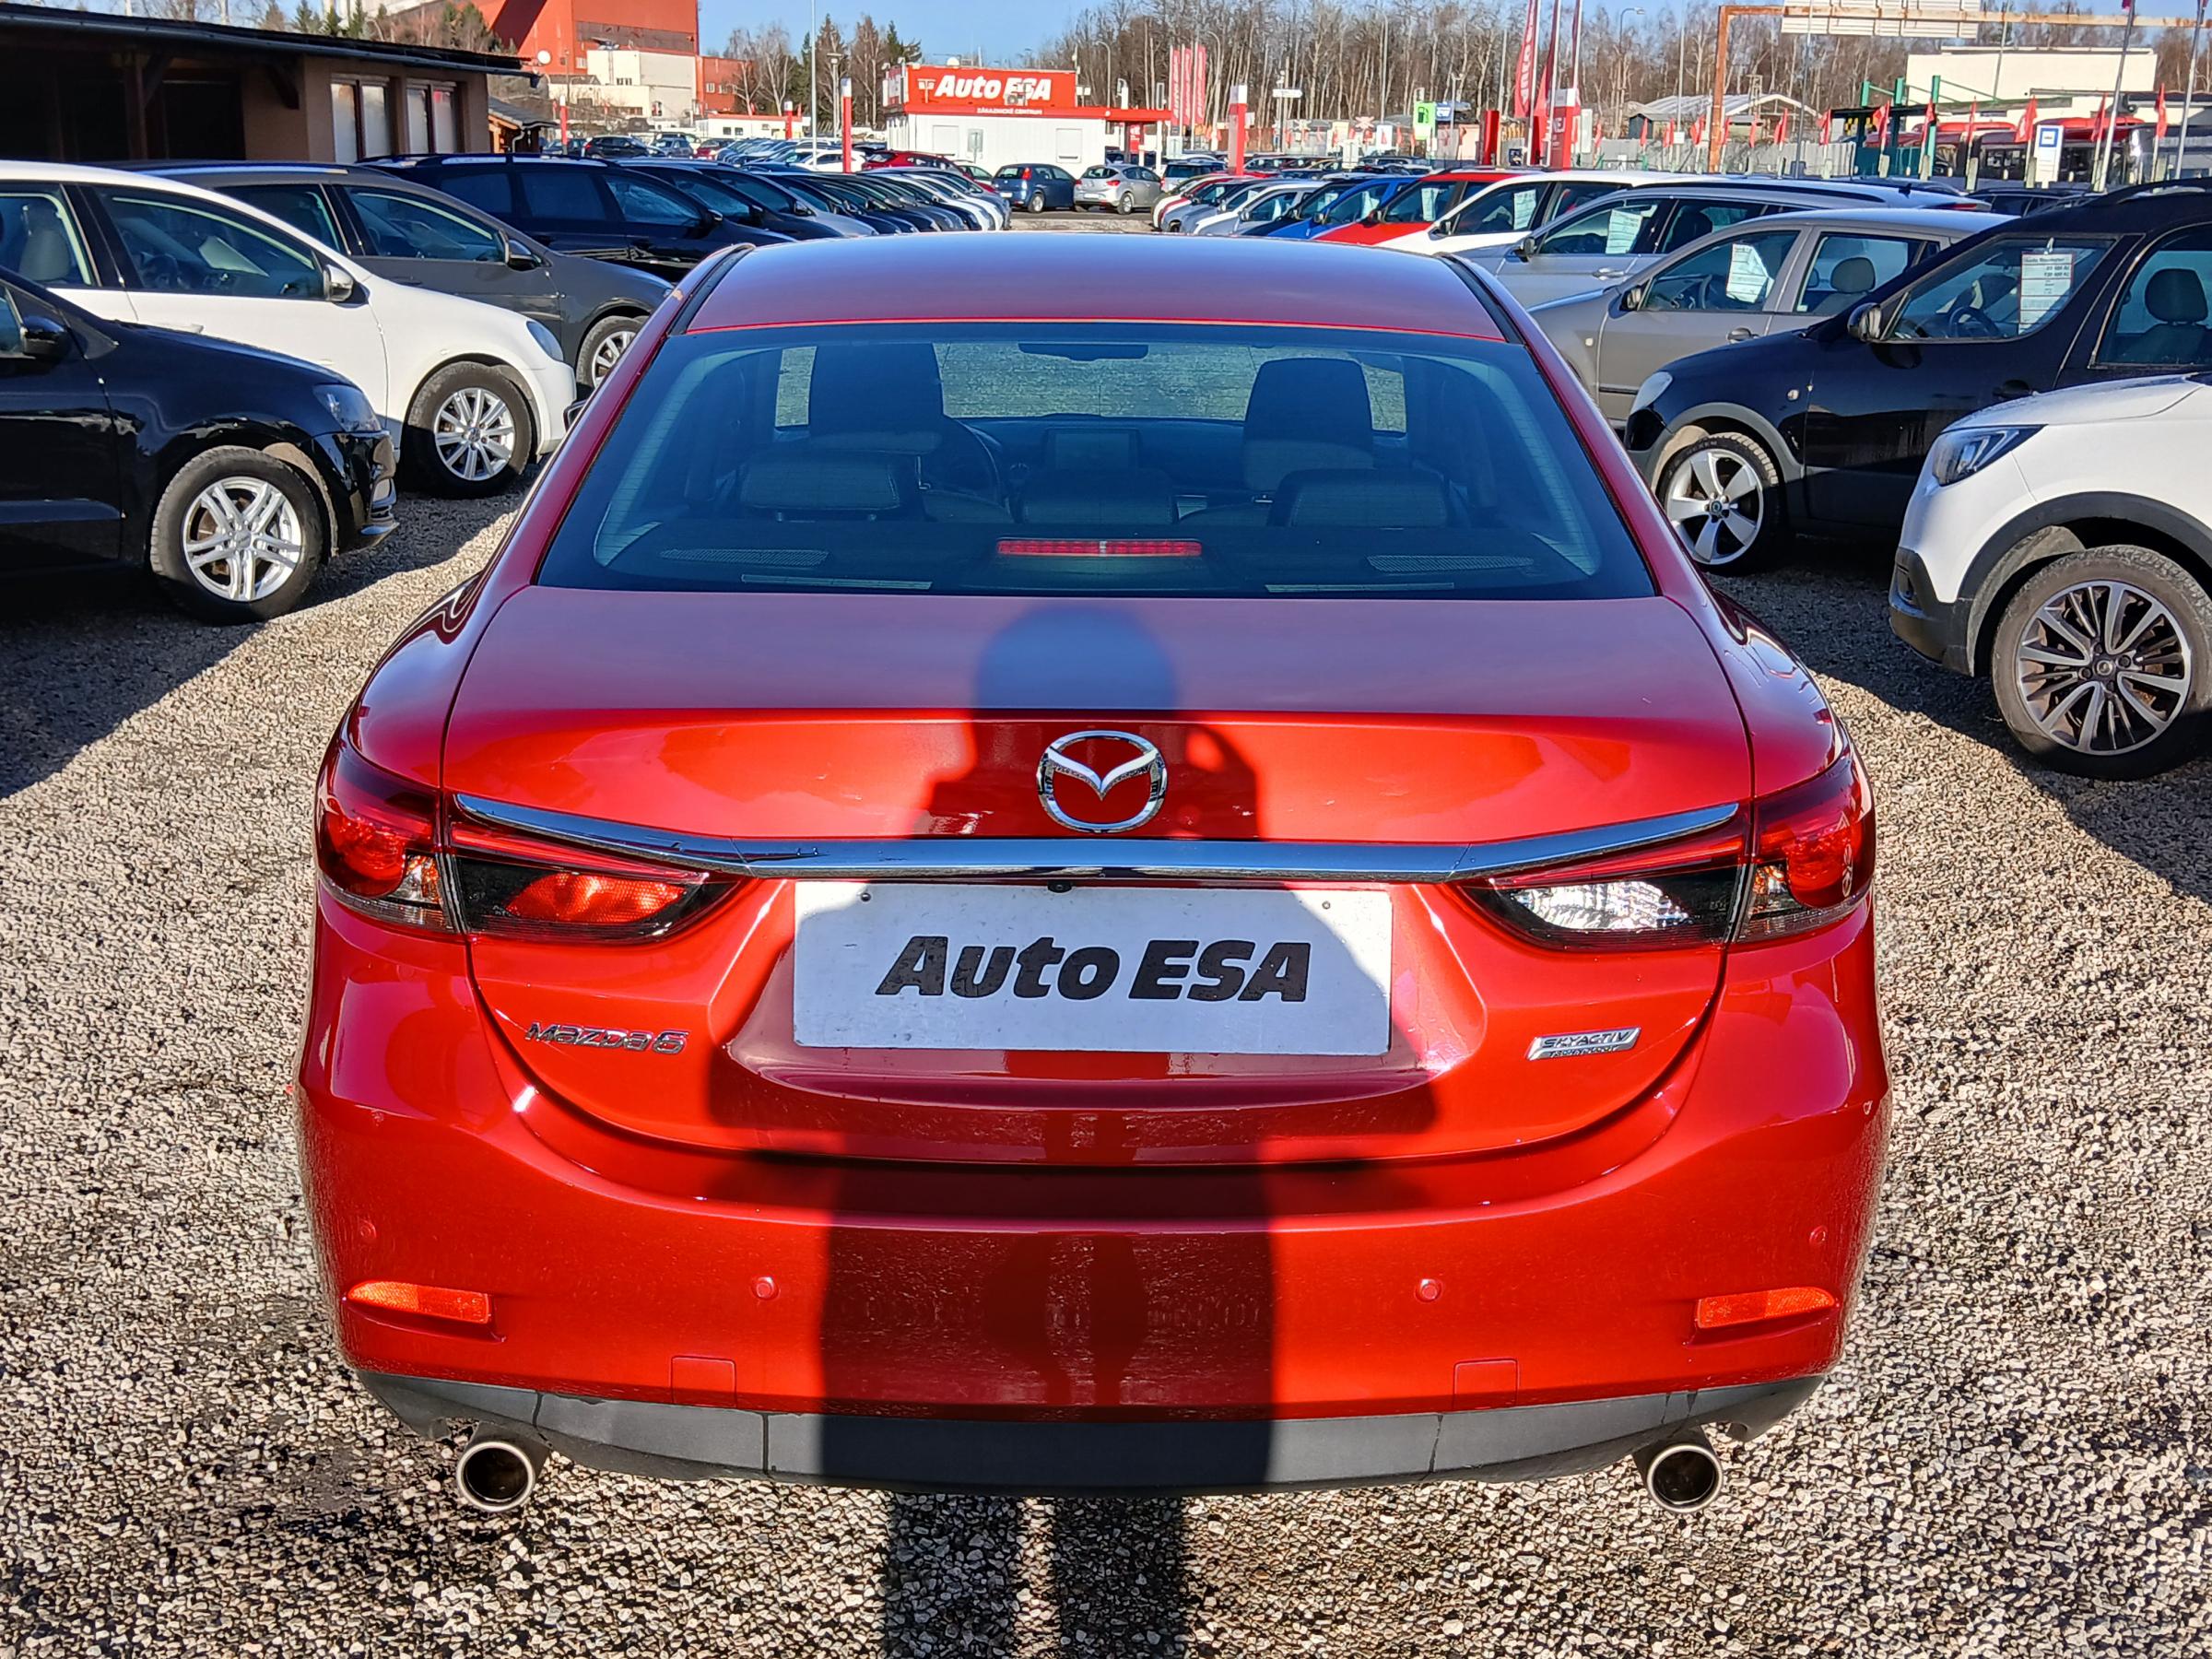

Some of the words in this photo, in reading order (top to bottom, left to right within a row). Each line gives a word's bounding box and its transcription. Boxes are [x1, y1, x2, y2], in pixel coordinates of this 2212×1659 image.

[934, 75, 1002, 100] Auto
[1003, 76, 1053, 101] ESA
[874, 935, 1122, 1001] Auto
[1128, 939, 1312, 1003] ESA
[652, 1029, 689, 1055] 6
[1542, 1031, 1630, 1049] SKYACTIV
